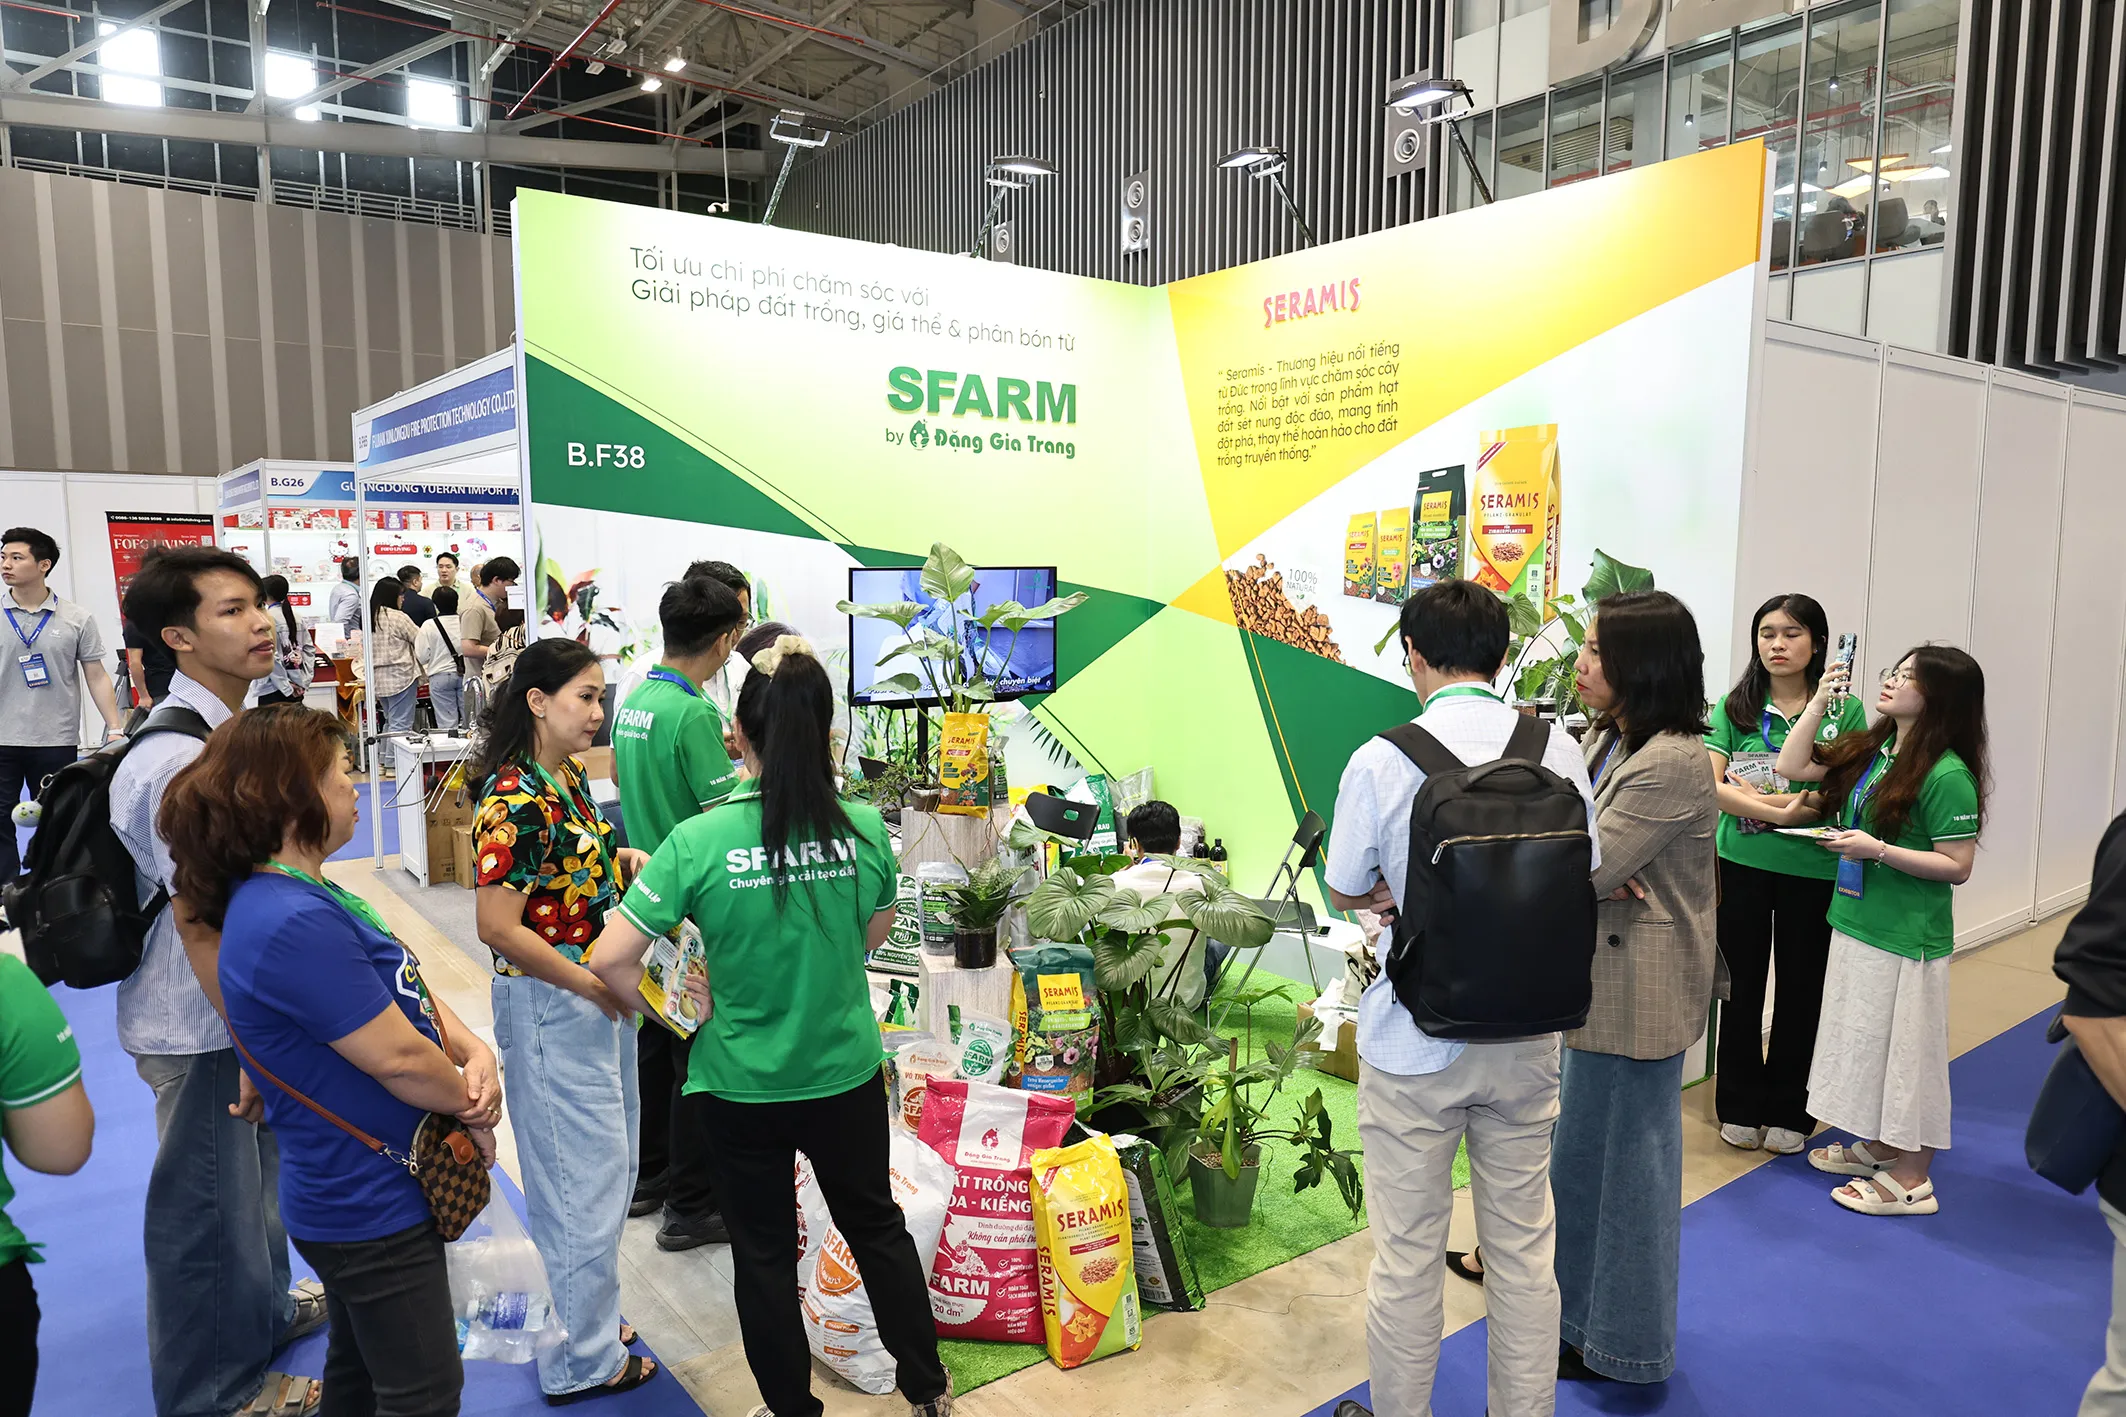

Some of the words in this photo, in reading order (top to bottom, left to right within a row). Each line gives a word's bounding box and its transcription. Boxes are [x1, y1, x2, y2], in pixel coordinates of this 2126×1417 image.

[630, 246, 663, 271] Tối
[674, 257, 702, 276] ưu
[711, 260, 743, 282] chi
[753, 266, 785, 290] phí
[793, 271, 852, 296] chăm
[860, 281, 895, 302] sóc
[901, 287, 928, 306] với
[1263, 277, 1361, 328] SERAMIS
[632, 279, 680, 303] Giải
[691, 287, 750, 317] pháp
[758, 293, 796, 317] đất
[804, 299, 865, 331] trồng,
[873, 310, 904, 333] giá
[912, 312, 942, 335] thể
[948, 320, 961, 337] &
[969, 322, 1014, 344] phân
[1020, 328, 1052, 348] bón
[1058, 333, 1075, 351] từ
[1226, 363, 1265, 381] Seramis
[1277, 358, 1316, 372] Thương
[1320, 350, 1344, 367] hiệu
[1348, 343, 1366, 361] nổi
[1370, 339, 1400, 358] tiếng
[1218, 386, 1228, 399] từ
[1230, 384, 1249, 397] Đức
[1251, 381, 1278, 395] trong
[1280, 376, 1298, 390] lĩnh
[1300, 374, 1320, 390] vực
[1322, 368, 1353, 383] chăm
[1356, 364, 1376, 379] sóc
[1378, 360, 1400, 377] cây
[887, 366, 1077, 424] SFARM
[1250, 395, 1267, 412] Nổi
[1272, 394, 1289, 411] bật
[1295, 390, 1311, 405] với
[1315, 388, 1335, 404] sản
[1340, 381, 1373, 404] phẩm
[1379, 380, 1399, 396] hạt
[450, 396, 491, 425] TECHNOLOGY
[1217, 417, 1234, 433] đất
[1238, 417, 1252, 431] sét
[1256, 416, 1281, 430] nung
[1285, 410, 1305, 427] độc
[1309, 408, 1333, 422] đáo,
[1338, 405, 1371, 419] mang
[1377, 398, 1398, 413] tính
[885, 428, 905, 446] by
[934, 428, 983, 454] Đặng
[989, 433, 1022, 452] Gia
[1027, 434, 1076, 460] Trang
[1217, 437, 1233, 452] đột
[1235, 433, 1256, 451] phá,
[1258, 432, 1281, 447] thay
[1282, 426, 1300, 442] thế
[1301, 426, 1329, 440] hoàn
[1331, 423, 1352, 438] hảo
[1354, 421, 1376, 435] cho
[1377, 415, 1398, 432] đất
[567, 442, 646, 469] B.F38
[1245, 447, 1277, 466] truyền
[270, 477, 304, 488] B.G26
[1423, 501, 1448, 511] SERAMIS
[1480, 492, 1540, 512] SERAMIS
[1380, 534, 1403, 543] SERAMIS
[1544, 503, 1556, 599] SERAMIS
[1286, 581, 1317, 595] NATURAL
[1289, 569, 1318, 585] 100%
[1000, 677, 1026, 688] chuyên
[1027, 676, 1041, 685] biệt
[1733, 763, 1757, 775] FARM
[1097, 823, 1111, 831] RAU
[729, 876, 775, 890] Chuyên
[798, 870, 815, 882] cải
[817, 868, 837, 882] tạo
[1043, 987, 1079, 998] SERAMIS
[1015, 1011, 1027, 1054] SERAMIS
[963, 1049, 993, 1066] SFARM
[901, 1176, 919, 1195] Trang
[953, 1169, 970, 1189] ẤT
[973, 1174, 1029, 1193] TRỒNG
[948, 1194, 968, 1208] OA
[980, 1193, 1032, 1213] KIỂNG
[1056, 1199, 1124, 1232] SERAMIS
[931, 1272, 990, 1296] FARM
[1038, 1245, 1056, 1317] SERAMIS
[934, 1304, 944, 1314] 20
[946, 1307, 964, 1317] dm³
